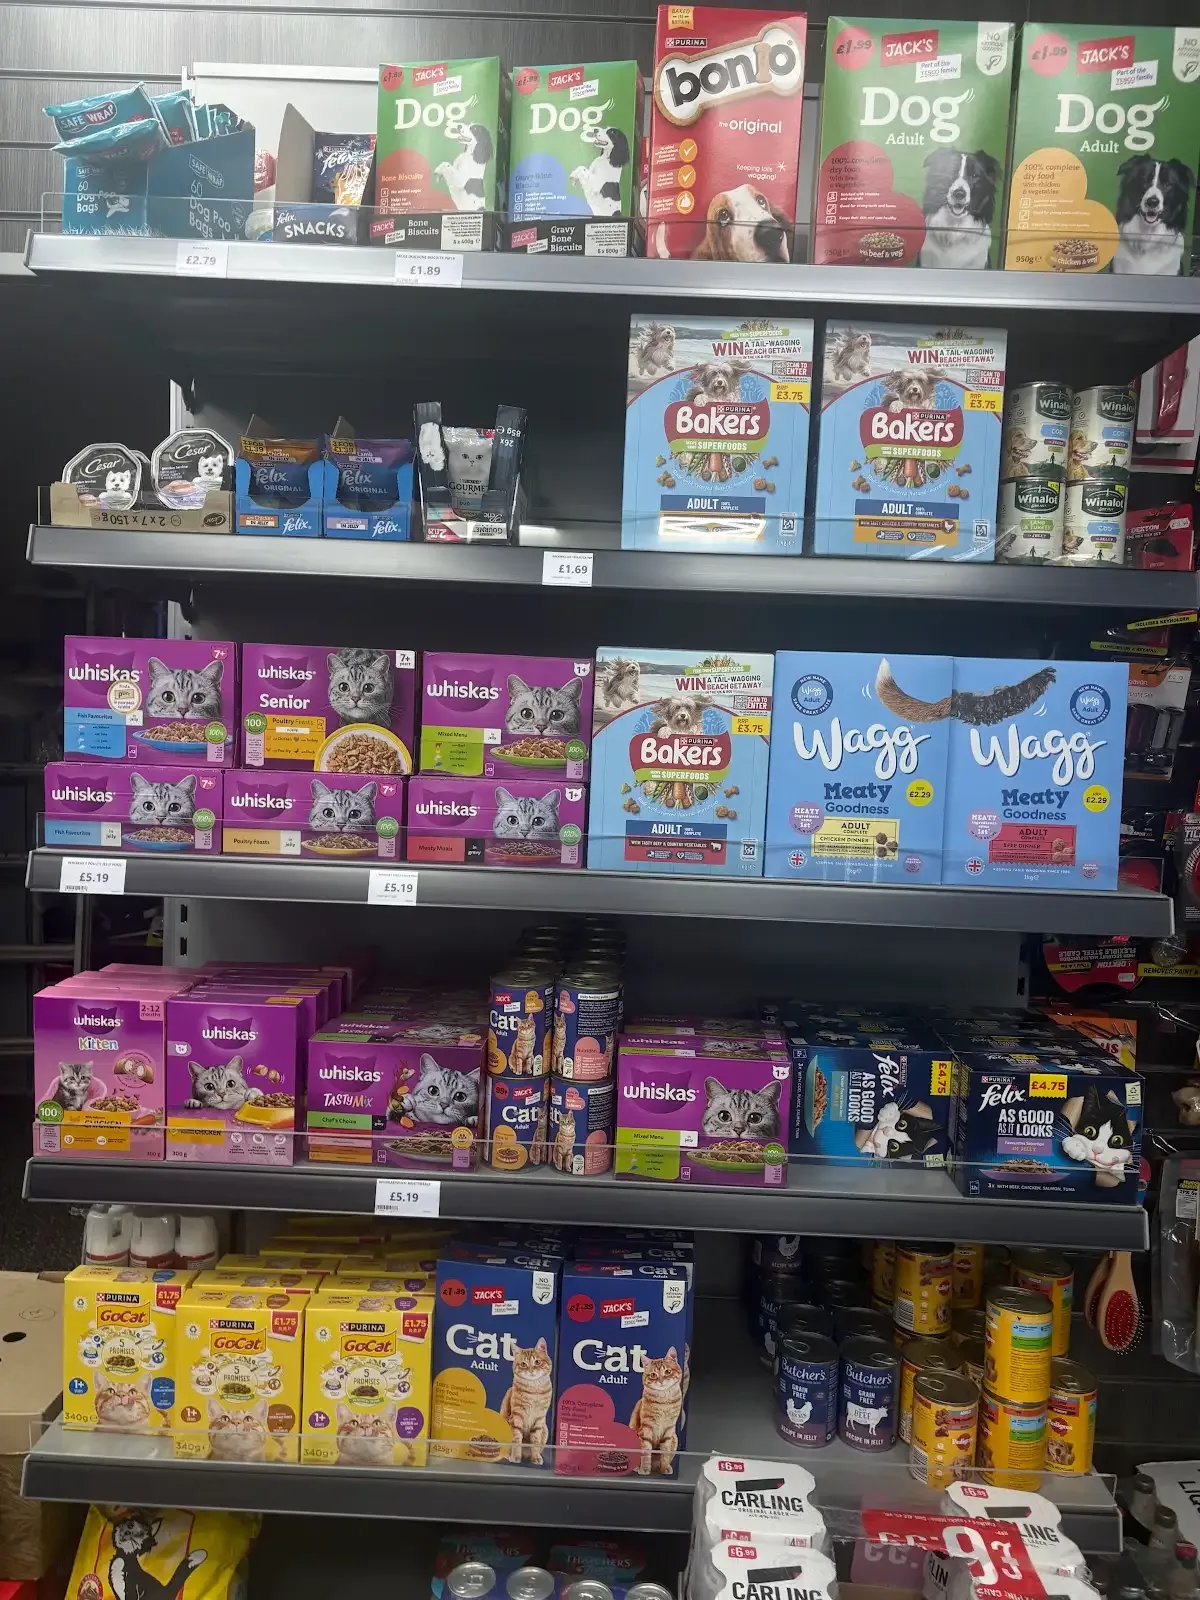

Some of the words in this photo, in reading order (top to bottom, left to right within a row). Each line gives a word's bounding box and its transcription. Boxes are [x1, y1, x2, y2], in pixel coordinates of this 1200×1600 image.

[836, 39, 872, 55] £1.99
[885, 39, 934, 57] JACK'S
[1080, 45, 1130, 65] JACK'S
[666, 42, 796, 107] bonio
[61, 115, 84, 129] SAFE
[87, 104, 114, 123] WRAP
[394, 95, 475, 138] Dog
[529, 98, 609, 143] Dog
[859, 87, 970, 143] Dog
[1054, 93, 1165, 151] Dog
[885, 133, 925, 145] Adult
[1080, 140, 1120, 153] Adult
[736, 164, 761, 173] Keeping
[747, 172, 777, 181] wagging!
[1023, 173, 1037, 181] dry
[1038, 172, 1055, 180] food
[78, 181, 88, 191] 60
[191, 180, 202, 196] 60
[77, 203, 99, 213] Bags
[190, 197, 210, 218] Dog
[214, 210, 231, 233] Poo
[190, 211, 213, 238] Bags
[284, 222, 345, 238] SNACKS
[551, 226, 575, 235] Gravy
[407, 228, 439, 236] Biscuits
[550, 244, 583, 252] Biscuits
[185, 254, 216, 266] £2.79
[1016, 255, 1034, 264] 950g
[410, 266, 440, 275] £1.89
[744, 348, 767, 356] BEACH
[768, 346, 802, 355] GETAWAY
[939, 356, 962, 364] BEACH
[962, 355, 995, 363] GETAWAY
[786, 368, 807, 376] ENTER
[980, 377, 1000, 385] ENTER
[776, 391, 803, 401] £3.75
[970, 400, 996, 409] £3.75
[676, 405, 761, 436] Bakers
[508, 427, 522, 437] 85g
[871, 411, 955, 443] Bakers
[174, 444, 211, 459] Cesar
[697, 441, 748, 451] SUPERFOODS
[893, 447, 942, 458] SUPERFOODS
[85, 460, 121, 474] Cesar
[263, 485, 304, 493] ORIGINAL
[348, 486, 388, 494] ORIGINAL
[1018, 494, 1058, 505] Winalot
[882, 503, 914, 515] ADULT
[282, 518, 308, 535] felix
[372, 521, 398, 537] felix
[558, 564, 588, 575] £1.69
[214, 649, 226, 658] 7+
[258, 665, 314, 681] whiskas
[675, 677, 707, 691] WIN
[713, 675, 761, 683] TAIL-WAGGING
[427, 680, 500, 700] whiskas
[260, 694, 311, 709] Senior
[747, 702, 768, 710] ENTER
[272, 717, 294, 726] Poultry
[737, 724, 763, 733] £3.75
[641, 737, 723, 767] Bakers
[793, 717, 932, 781] Wagg
[970, 723, 1108, 787] Wagg
[661, 771, 710, 780] SUPERFOODS
[201, 779, 214, 788] 7+
[51, 786, 114, 803] whiskas
[824, 783, 892, 803] Meaty
[1001, 788, 1070, 809] Meaty
[231, 793, 293, 810] whiskas
[415, 800, 478, 817] whiskas
[825, 802, 889, 815] Goodness
[1003, 808, 1067, 821] Goodness
[651, 824, 682, 835] ADULT
[841, 822, 871, 830] ADULT
[1018, 828, 1048, 836] ADULT
[79, 872, 109, 883] £5.19
[384, 883, 413, 893] £5.19
[141, 1004, 160, 1013] 2-12
[73, 1014, 121, 1028] whiskas
[202, 1026, 256, 1041] whiskas
[78, 1036, 119, 1050] Kitten
[319, 1065, 381, 1083] whiskas
[775, 1069, 787, 1077] 1+
[861, 1072, 876, 1085] AS
[937, 1062, 948, 1094] £4.75
[623, 1081, 697, 1102] whiskas
[1031, 1081, 1065, 1091] £4.75
[978, 1083, 1025, 1112] felix
[860, 1090, 875, 1124] GOOD
[502, 1105, 538, 1123] Cat
[999, 1109, 1015, 1123] AS
[1018, 1109, 1055, 1124] GOOD
[998, 1124, 1007, 1134] AS
[1008, 1123, 1014, 1133] IT
[1016, 1123, 1053, 1138] LOOKS
[389, 1192, 419, 1203] £5.19
[106, 1294, 138, 1302] PURINA
[474, 1290, 503, 1300] JACK'S
[602, 1302, 633, 1313] JACK'S
[100, 1309, 146, 1323] GoCat
[274, 1317, 296, 1325] £1.75
[219, 1321, 253, 1329] PURINA
[350, 1323, 384, 1332] PURINA
[404, 1319, 427, 1327] £1.75
[119, 1338, 125, 1347] 5
[213, 1336, 261, 1350] GoCat
[446, 1323, 518, 1362] Cat
[109, 1347, 135, 1355] PROMISES
[572, 1339, 648, 1373] Cat
[470, 1360, 499, 1372] Adult
[781, 1357, 826, 1382] Butcher's
[599, 1374, 628, 1385] Adult
[845, 1364, 893, 1384] Butcher's
[791, 1383, 808, 1393] GRAIN
[858, 1389, 875, 1399] GRAIN
[793, 1391, 807, 1399] FREE
[860, 1397, 874, 1405] FREE
[65, 1413, 89, 1423] 340g
[781, 1424, 797, 1438] RECIPE
[803, 1433, 818, 1441] JELLY
[721, 1490, 804, 1513] CARLING
[738, 1507, 767, 1515] ORIGINAL
[730, 1546, 756, 1557] £6.99
